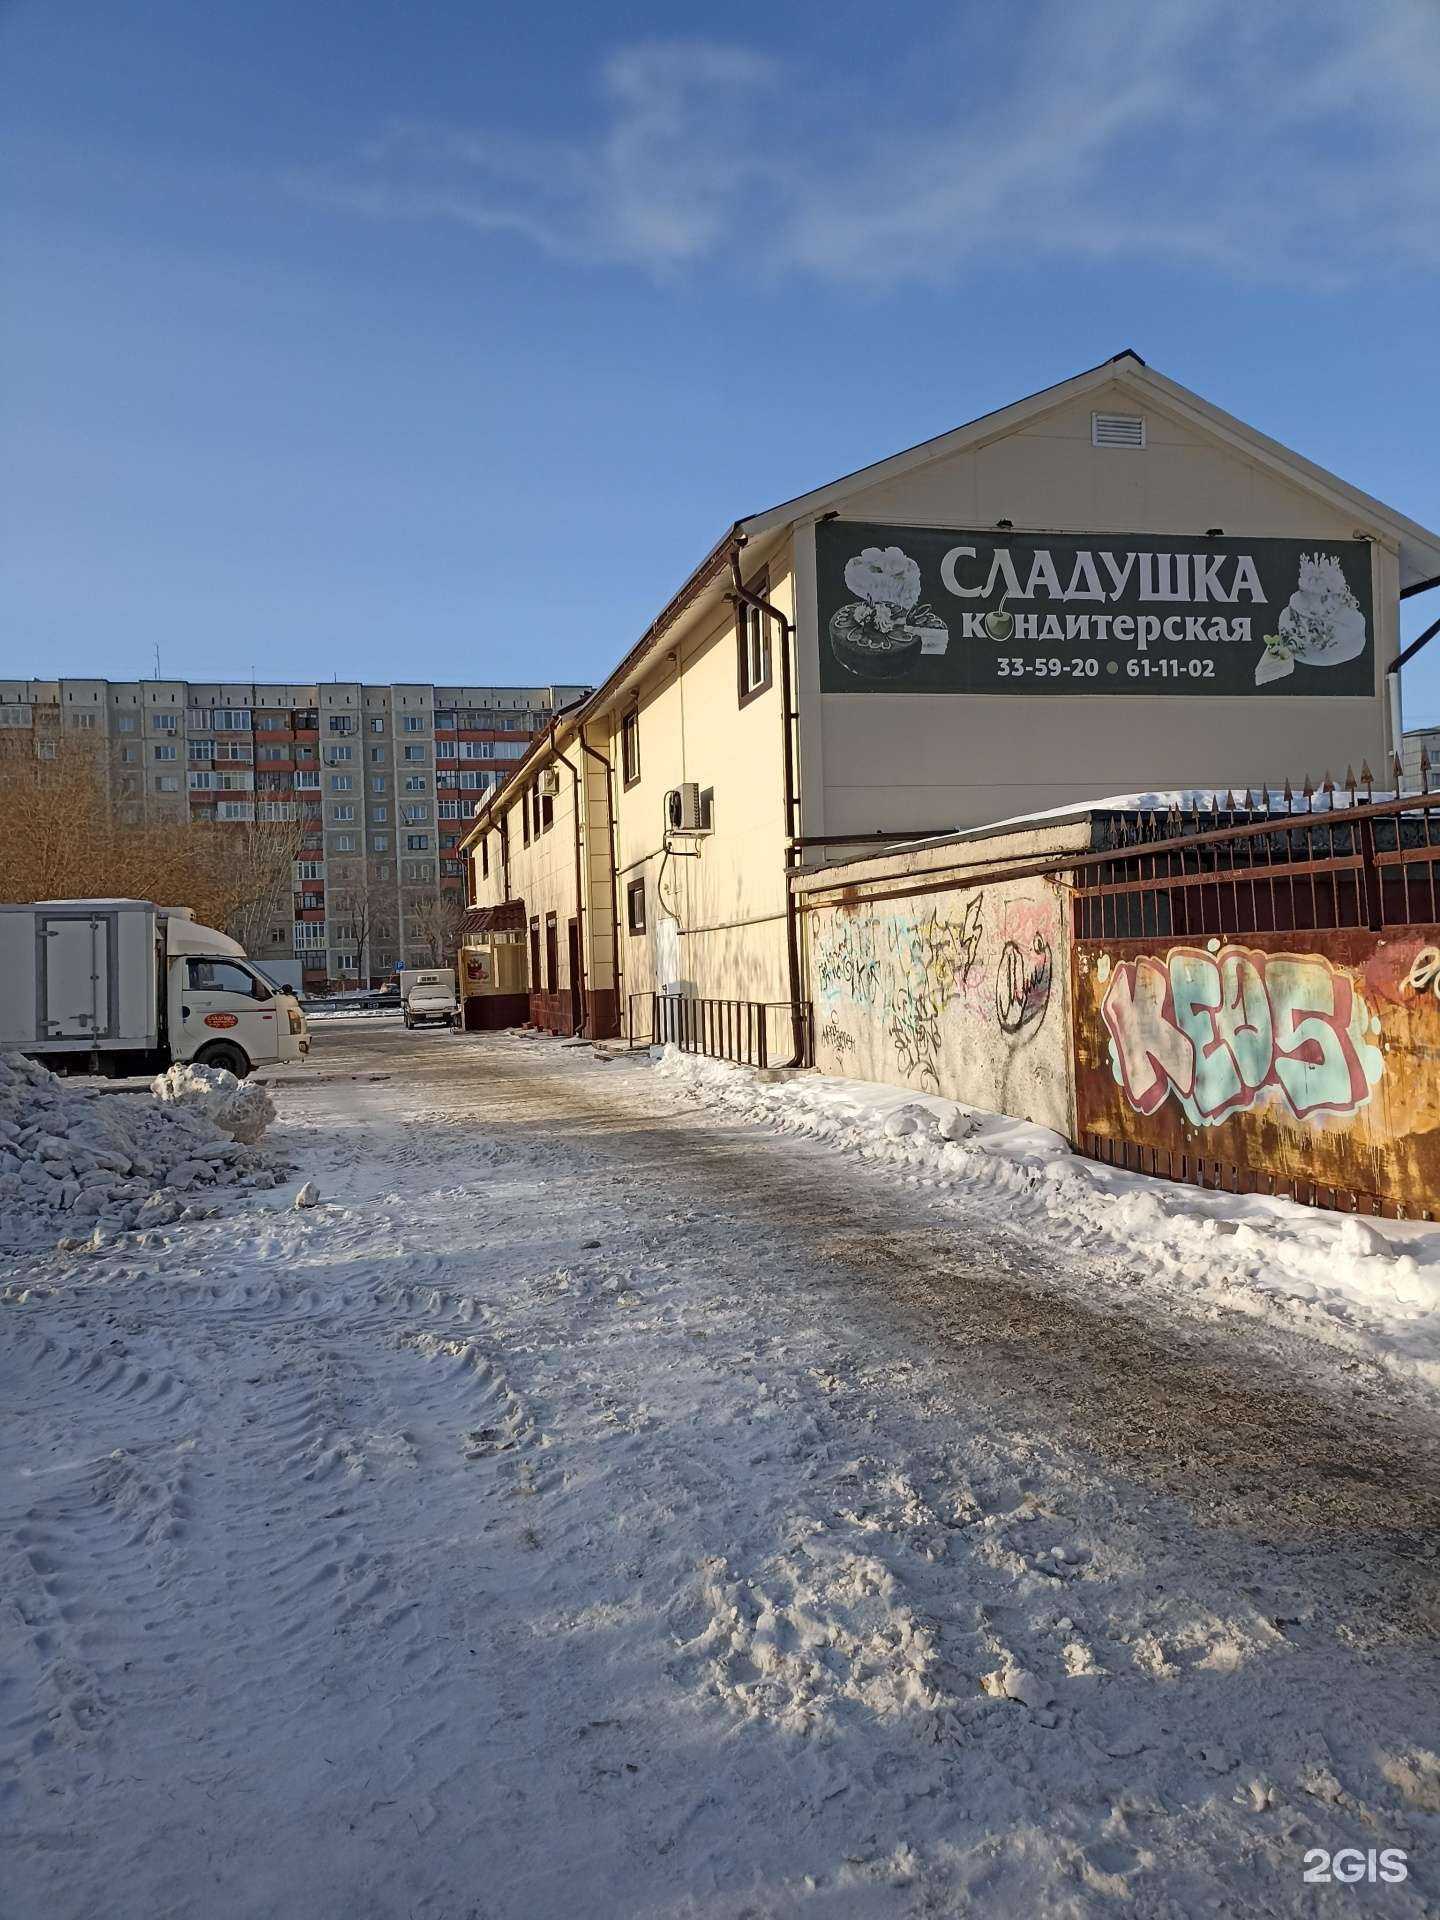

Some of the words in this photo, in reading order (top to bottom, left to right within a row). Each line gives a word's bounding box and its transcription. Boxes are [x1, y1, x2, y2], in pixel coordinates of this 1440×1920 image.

[940, 546, 1268, 604] СЛАДУШКА
[961, 611, 1252, 651] кондитерская
[997, 658, 1099, 678] 33-59-20
[1126, 659, 1215, 678] 61-11-02
